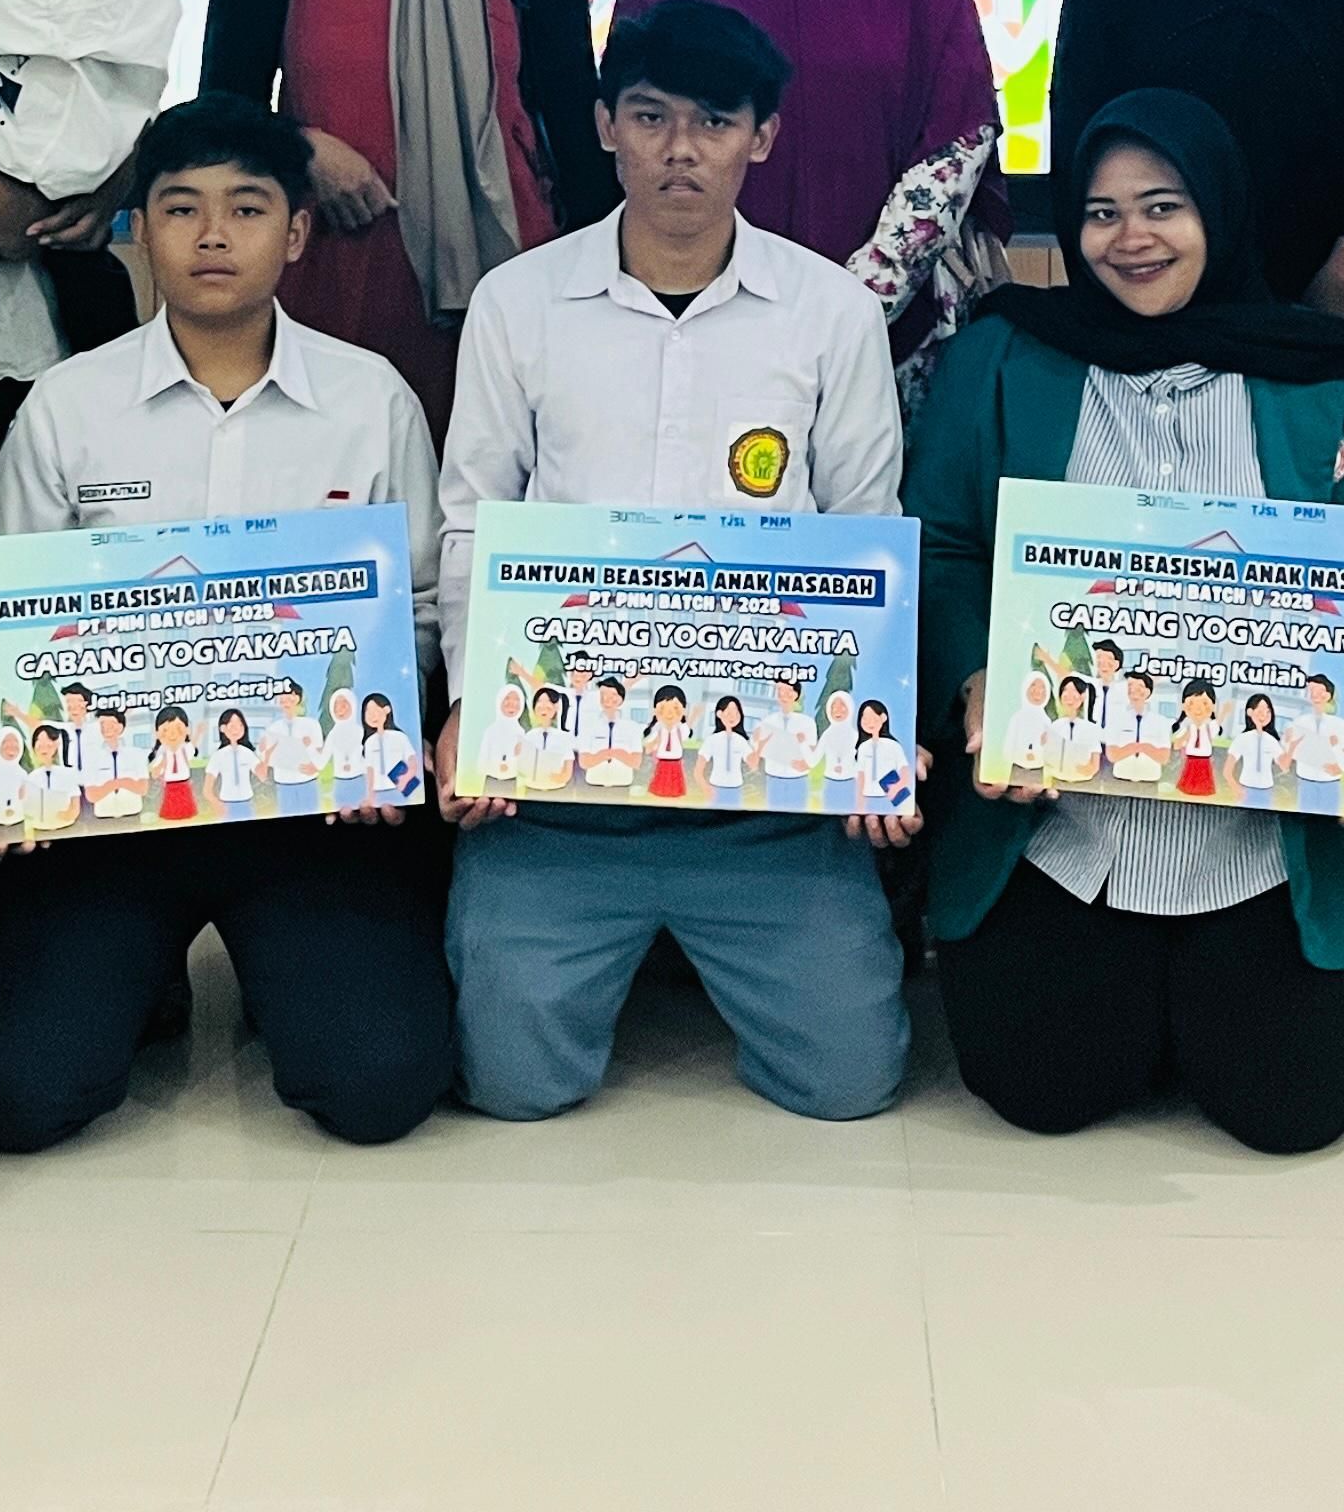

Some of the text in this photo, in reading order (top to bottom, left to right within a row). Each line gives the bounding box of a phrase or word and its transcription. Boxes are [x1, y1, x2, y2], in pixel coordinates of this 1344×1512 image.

[245, 518, 278, 531] PNM
[720, 514, 746, 528] TJSL
[760, 515, 792, 528] PNM
[1251, 503, 1279, 518] TJSL
[1293, 506, 1327, 520] PNM
[203, 521, 232, 536] TJSL
[500, 564, 874, 596] BANTUAN BEASISWA ANAK NASABAH
[1024, 545, 1122, 571] BANTUAN
[1130, 553, 1236, 581] BEASISWA
[1245, 563, 1302, 586] ANAK
[90, 585, 196, 612] BEASISWA
[205, 577, 261, 601] ANAK
[269, 569, 366, 596] NASABAH
[588, 591, 611, 608] PT
[615, 592, 653, 610] PNM
[658, 593, 715, 612] BATCH
[720, 596, 734, 613] V
[1115, 576, 1314, 610] PT PNM BATCH V 2025
[77, 604, 274, 635] PT PNM BATCH V 2025
[1051, 604, 1179, 639] CABANG
[525, 617, 858, 655] CABANG YOGYAKARTA
[16, 627, 357, 680] CABANG YOGYAKARTA
[564, 653, 817, 683] Jenjang SMA/SMK Sederajat
[1134, 653, 1307, 688] Jenjang Kuliah
[87, 677, 292, 712] Jenjang SMP Sederajat
